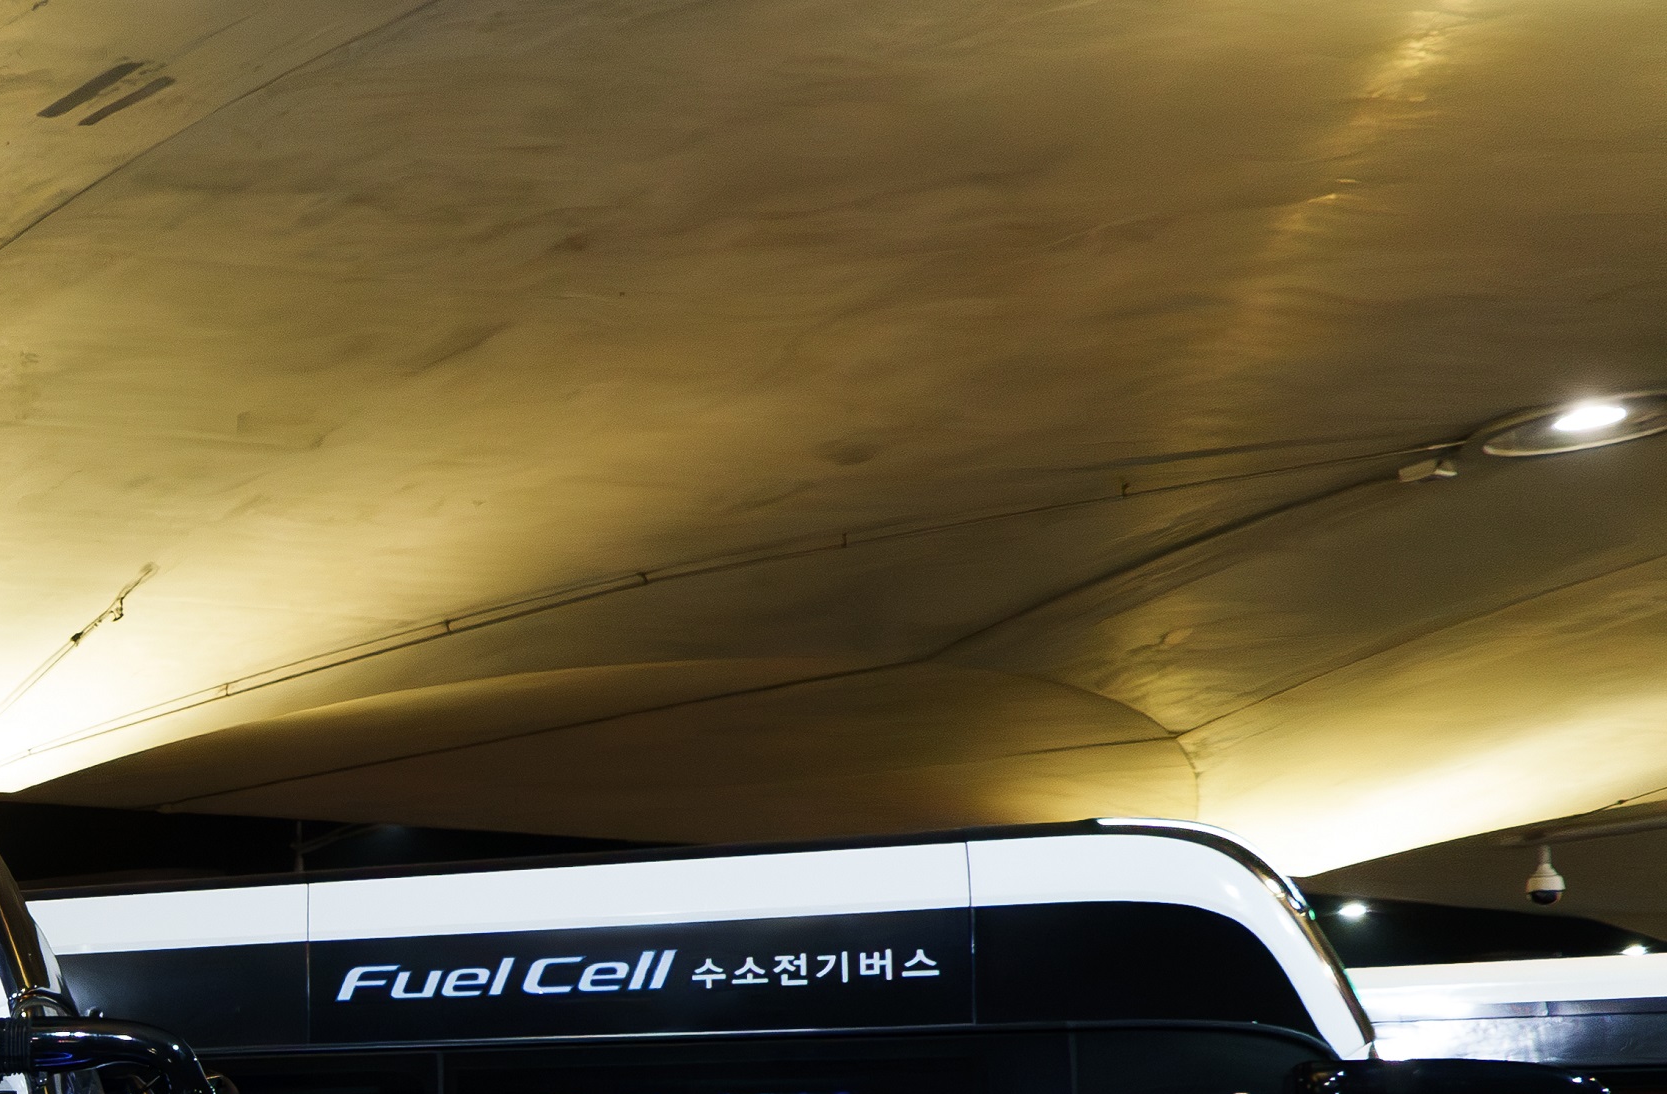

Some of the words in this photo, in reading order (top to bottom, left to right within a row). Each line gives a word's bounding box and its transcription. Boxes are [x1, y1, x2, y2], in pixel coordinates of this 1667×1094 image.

[336, 957, 515, 1002] Fuel
[521, 949, 677, 995] Cell
[691, 947, 940, 989] 수소전기버스
